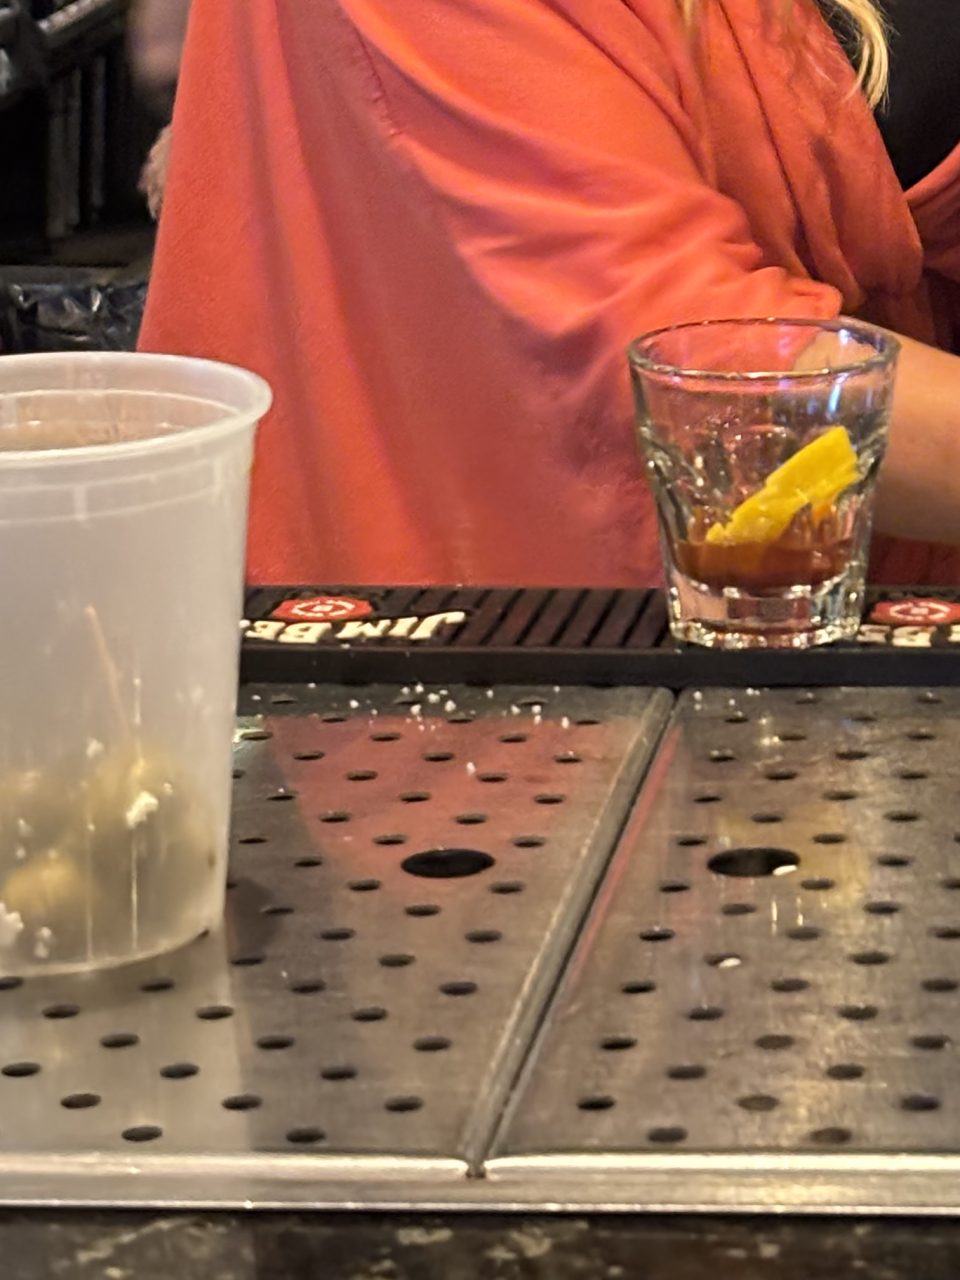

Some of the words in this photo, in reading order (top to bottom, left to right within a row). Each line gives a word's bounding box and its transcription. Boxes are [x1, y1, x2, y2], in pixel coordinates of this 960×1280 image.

[240, 619, 332, 644] BE
[335, 611, 465, 640] JIM
[856, 624, 937, 648] BE
